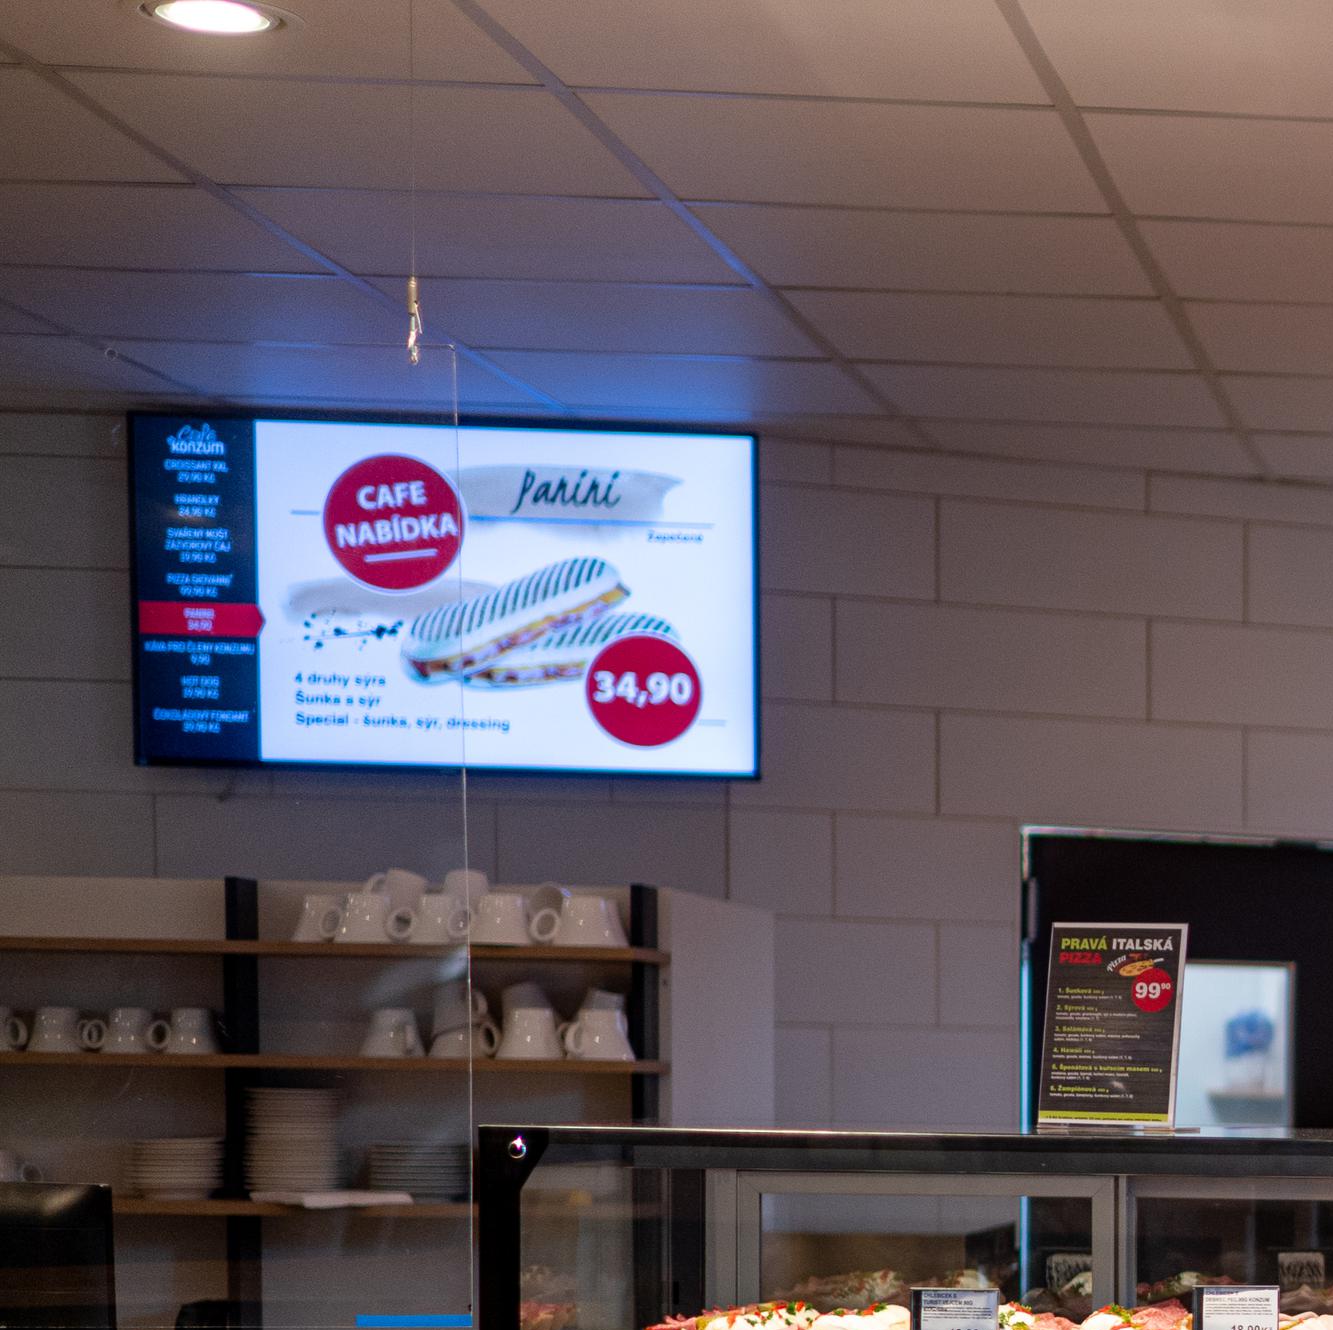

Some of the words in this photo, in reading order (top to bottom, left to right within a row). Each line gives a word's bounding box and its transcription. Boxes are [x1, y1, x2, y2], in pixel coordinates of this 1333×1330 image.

[356, 480, 428, 511] CAFE
[510, 468, 623, 515] Panini
[335, 512, 459, 548] NABÍDKA
[307, 673, 350, 688] druhy
[592, 670, 693, 708] 34,90
[1061, 936, 1108, 950] PRAVÁ
[1112, 936, 1173, 951] ITALSKÁ
